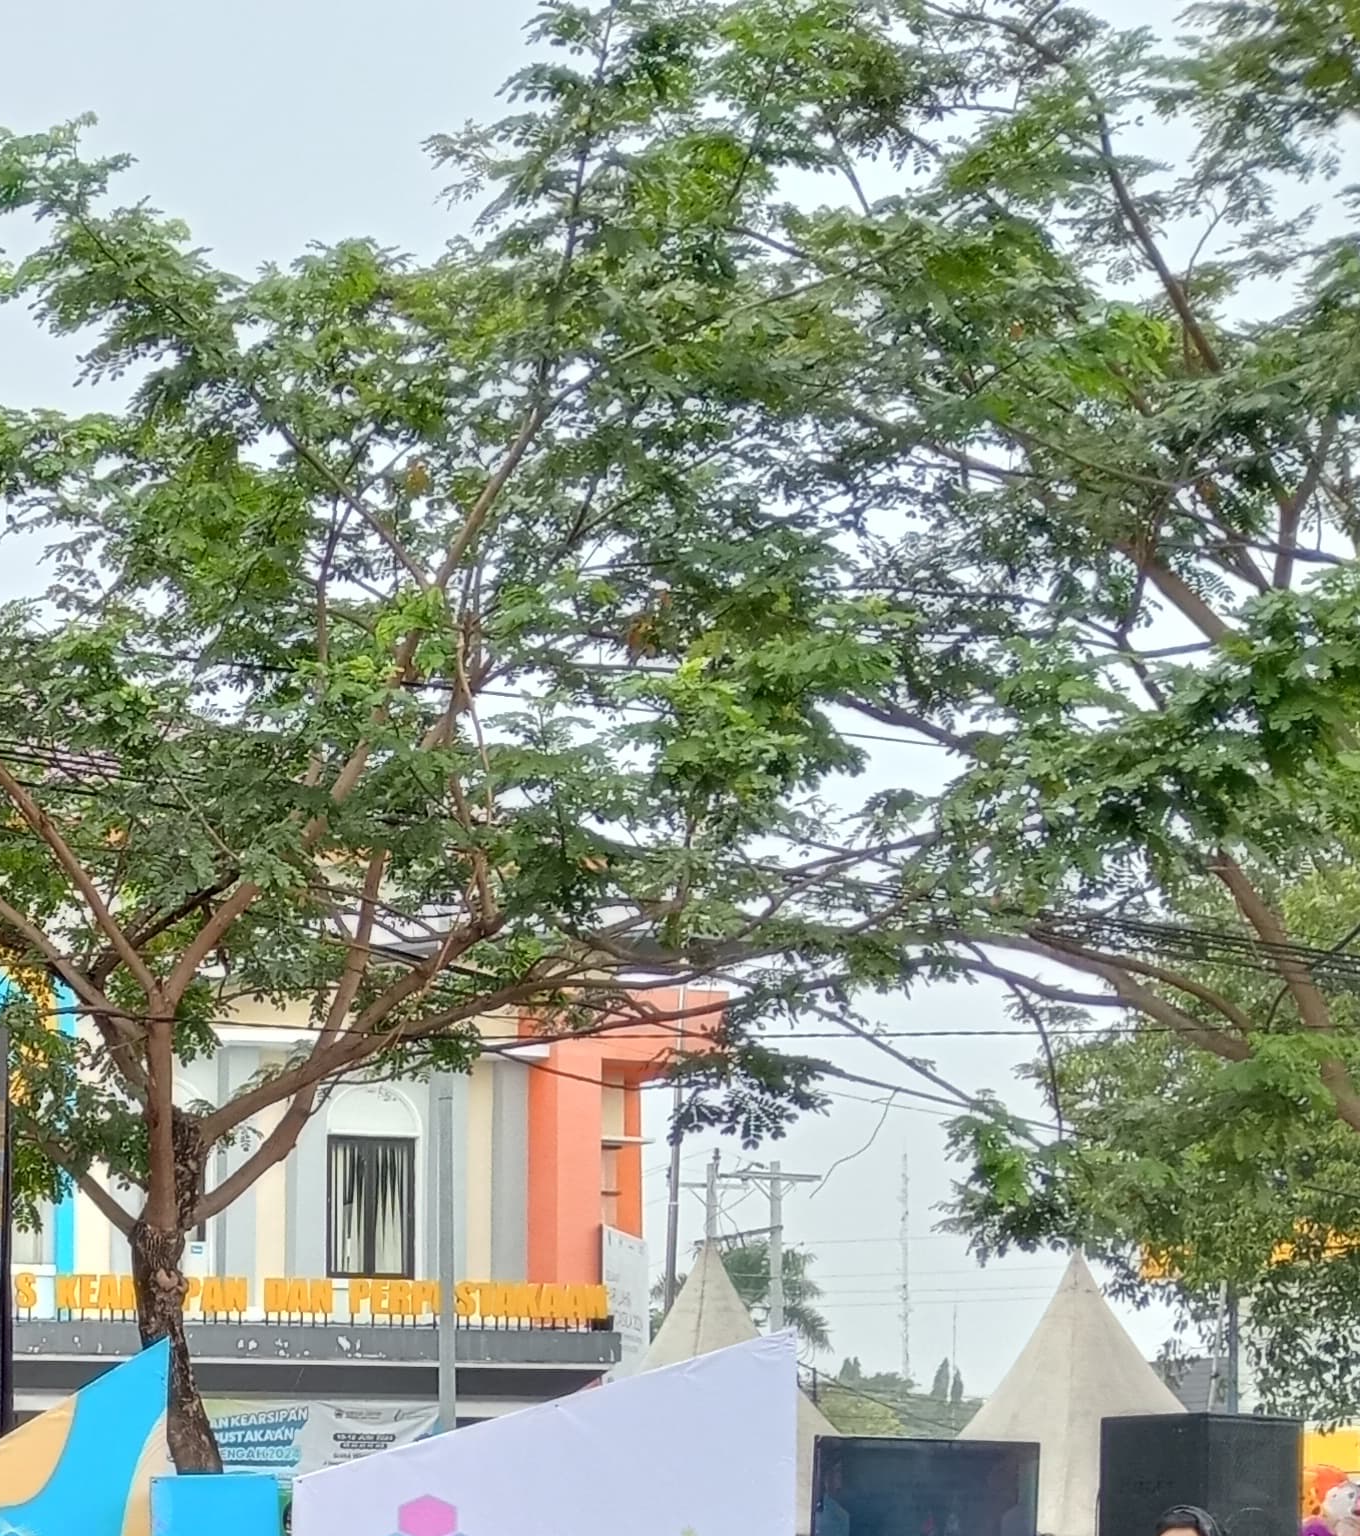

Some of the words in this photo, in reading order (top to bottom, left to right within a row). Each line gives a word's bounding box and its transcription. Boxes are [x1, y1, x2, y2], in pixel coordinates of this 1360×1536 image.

[264, 1277, 332, 1314] DAN
[230, 1406, 308, 1428] KEARSIPAN
[216, 1424, 294, 1444] USTAKAAN
[220, 1447, 265, 1461] ENGAH
